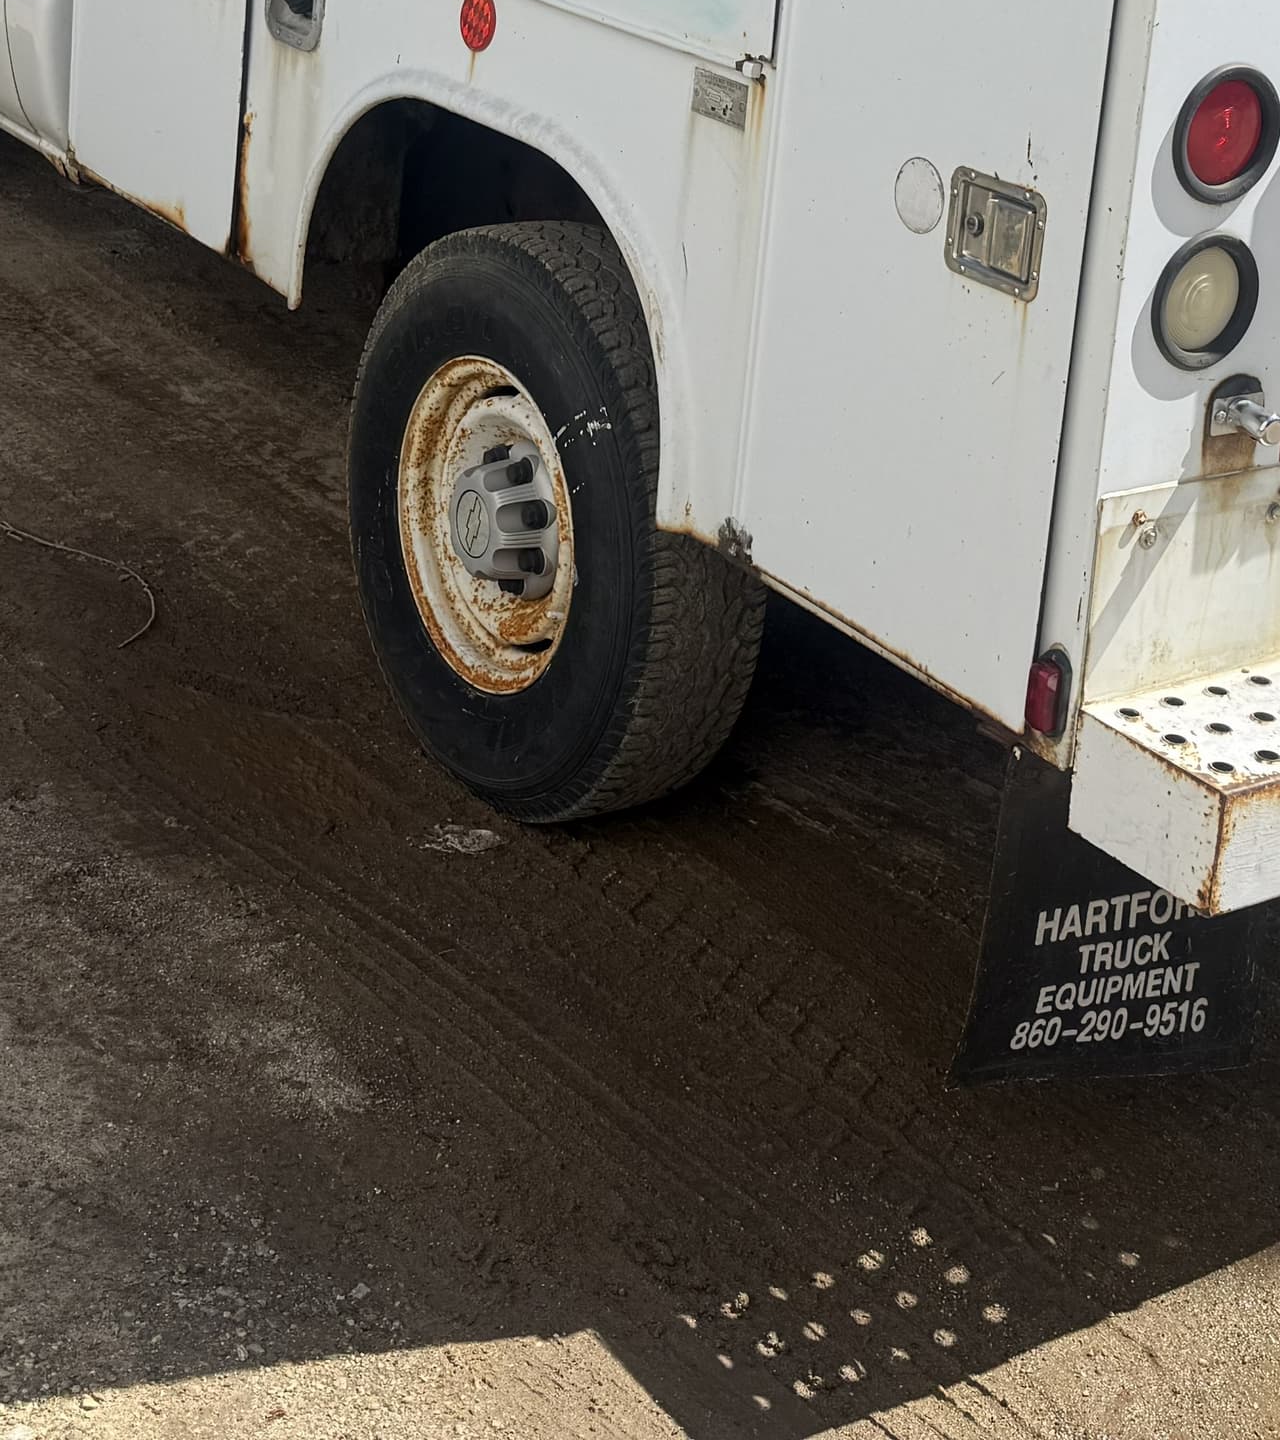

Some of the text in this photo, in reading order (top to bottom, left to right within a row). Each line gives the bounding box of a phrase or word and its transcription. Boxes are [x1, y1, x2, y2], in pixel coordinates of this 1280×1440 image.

[1035, 888, 1207, 946] HARTFO
[1079, 931, 1172, 974] TRUCK
[1035, 962, 1200, 1014] EQUIPMENT
[1010, 997, 1208, 1050] 860-290-9516
